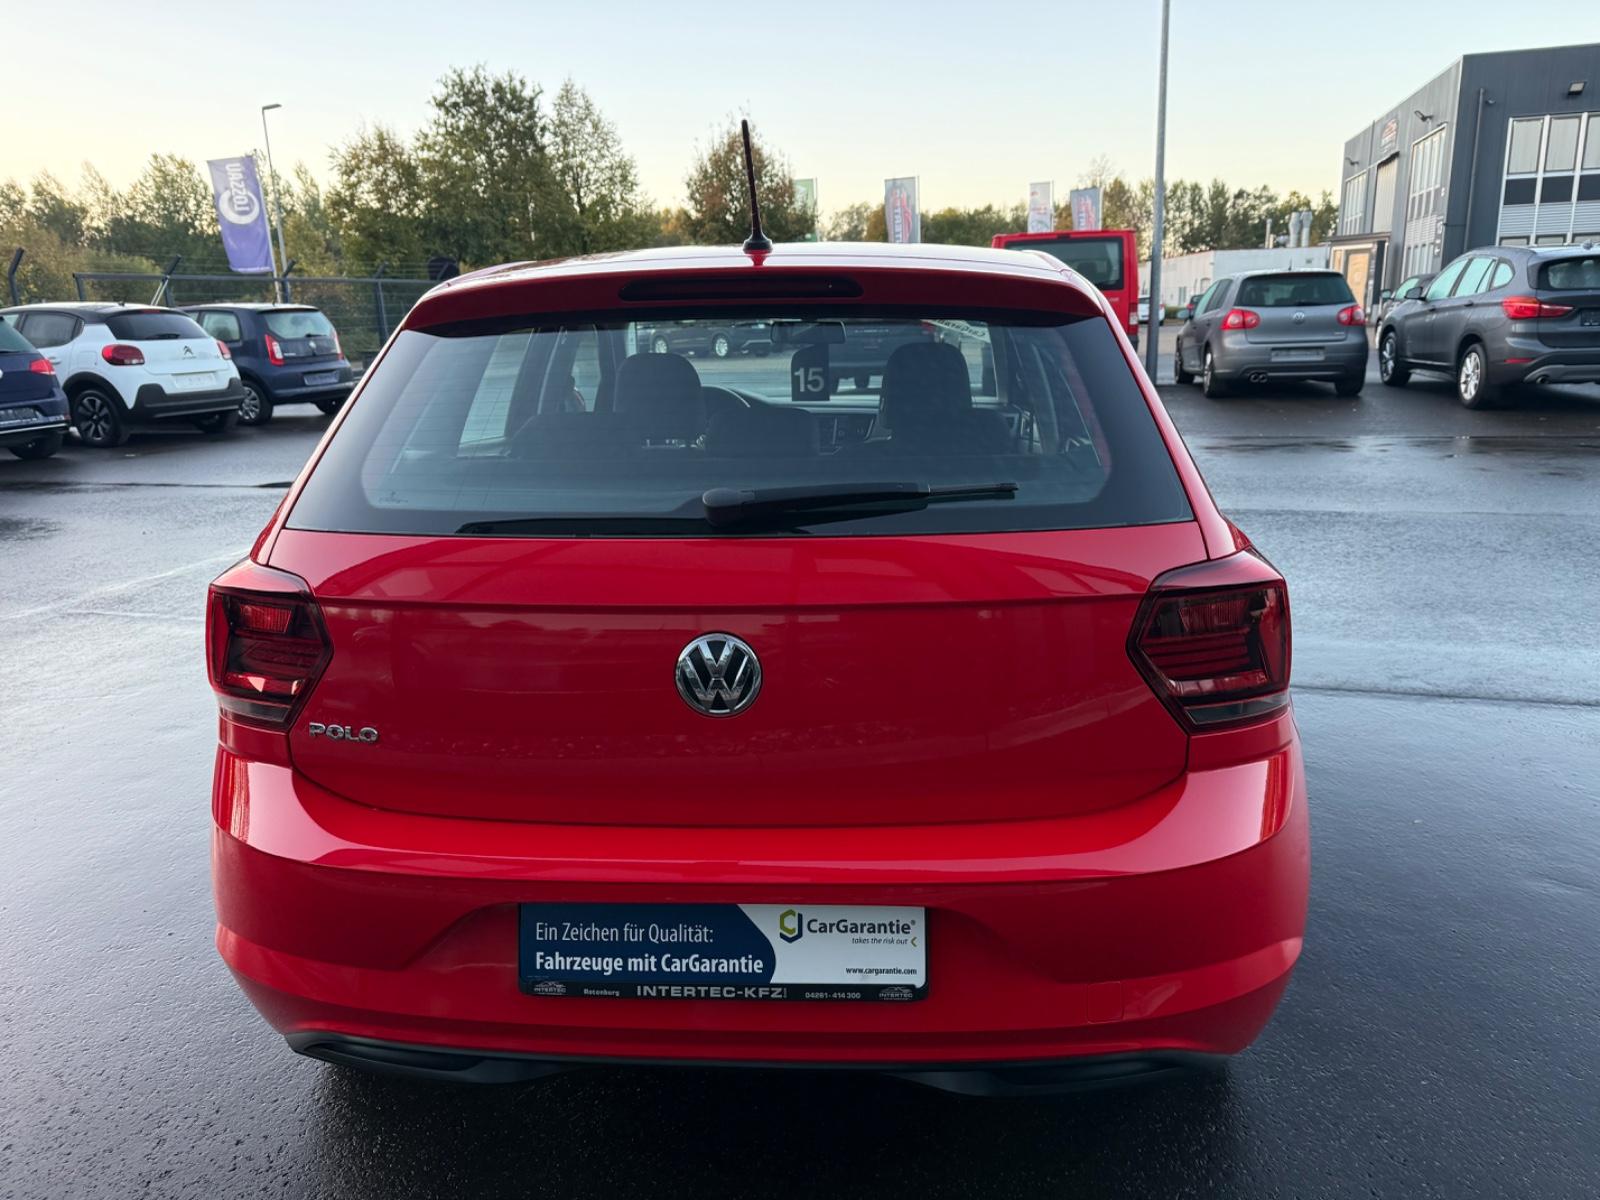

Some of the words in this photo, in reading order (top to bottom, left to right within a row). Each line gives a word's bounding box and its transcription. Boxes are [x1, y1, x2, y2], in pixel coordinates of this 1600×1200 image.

[794, 367, 825, 392] 15
[309, 722, 379, 743] POLO
[535, 922, 558, 941] Ein
[562, 922, 619, 942] Zeichen
[624, 923, 645, 942] für
[648, 923, 714, 944] Qualität:
[535, 951, 623, 975] Fahrzeuge
[628, 953, 657, 972] mit
[661, 953, 763, 973] CarGarantie
[845, 966, 917, 976] www.cargarantie.com
